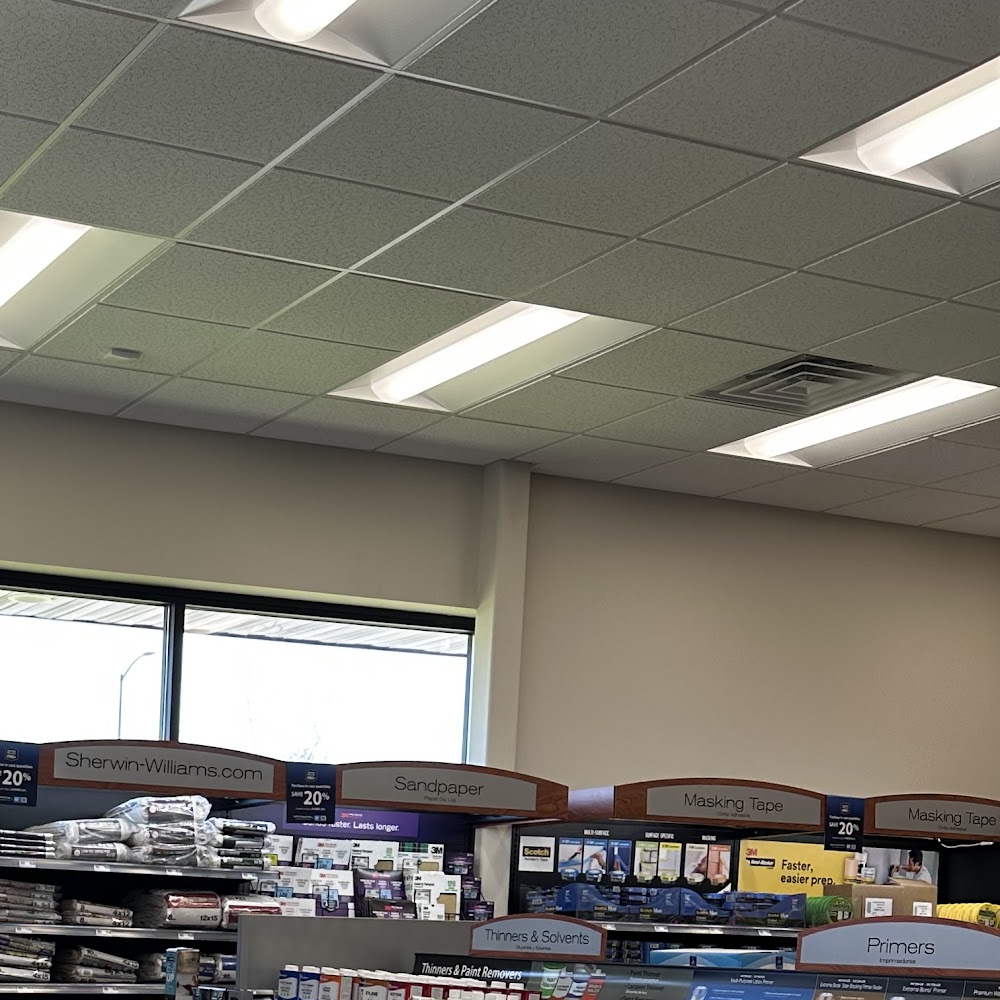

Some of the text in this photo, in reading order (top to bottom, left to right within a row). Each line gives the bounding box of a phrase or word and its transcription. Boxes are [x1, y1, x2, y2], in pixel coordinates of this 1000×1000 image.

[65, 752, 263, 781] Sherwin-Williams.com
[2, 770, 32, 786] 20%
[394, 775, 484, 798] Sandpaper
[304, 790, 330, 806] 20%
[684, 793, 784, 814] Masking Tape
[908, 806, 997, 828] Masking Tape
[353, 821, 374, 830] Lasts
[376, 823, 400, 832] longer.
[838, 822, 860, 836] 20%
[431, 846, 442, 854] 3M
[524, 847, 550, 856] Scotch
[746, 848, 758, 856] 3M
[782, 860, 814, 873] Faster,
[780, 874, 836, 886] easier prep.
[485, 928, 590, 945] Thinners & Solvents
[867, 937, 935, 955] Primers
[421, 962, 522, 980] Thinners & Paint Removers
